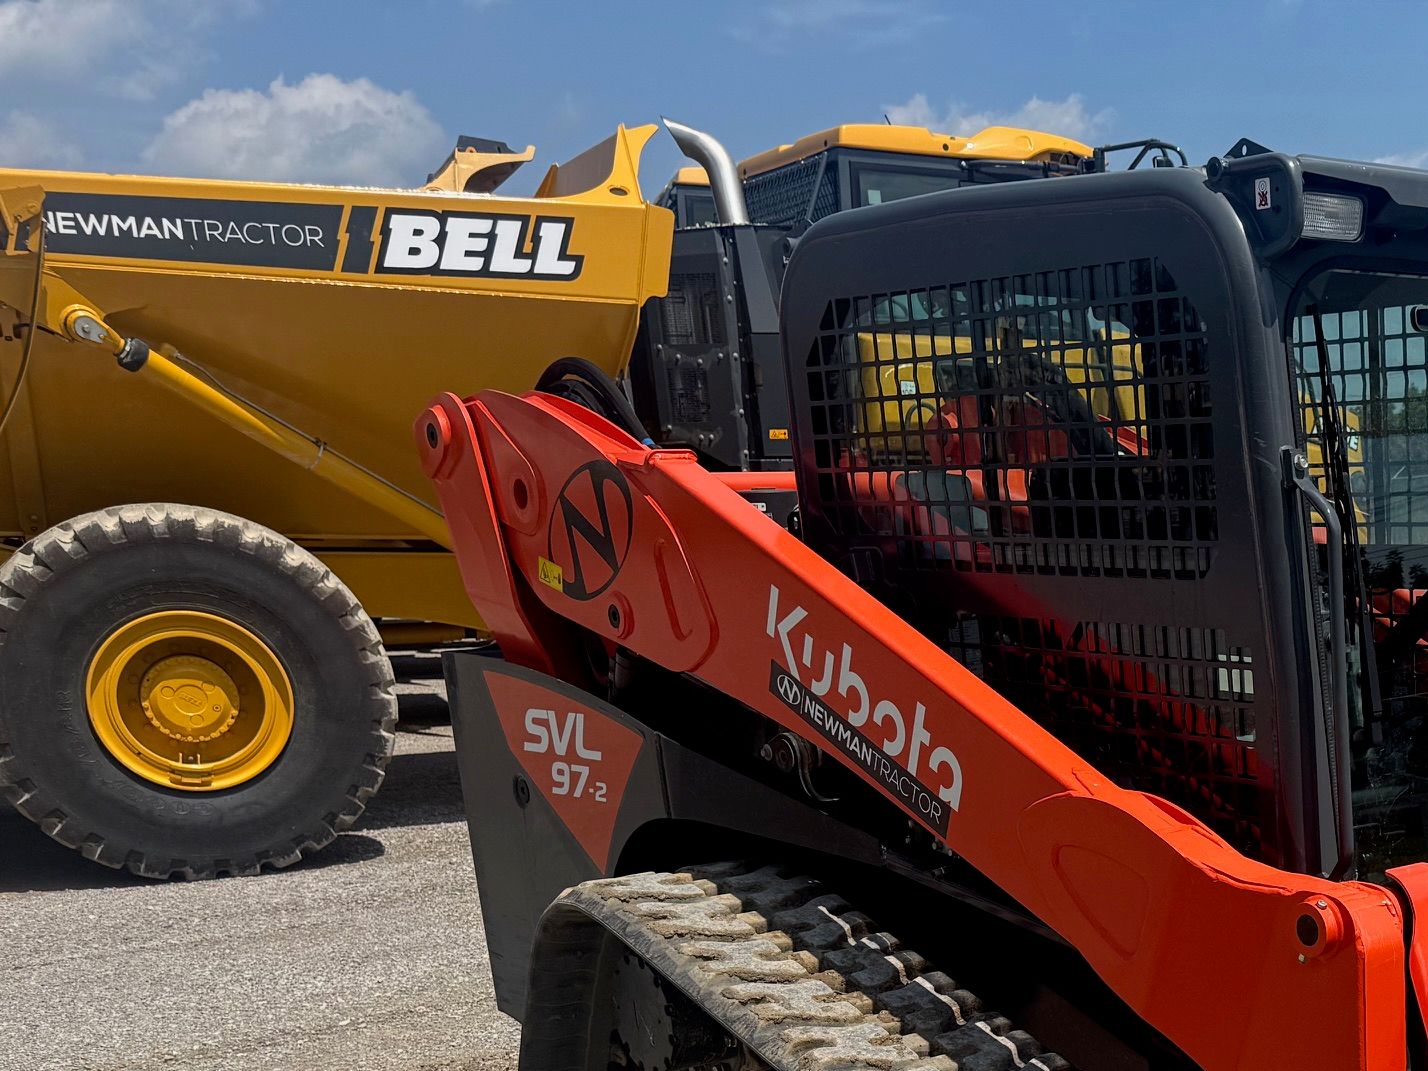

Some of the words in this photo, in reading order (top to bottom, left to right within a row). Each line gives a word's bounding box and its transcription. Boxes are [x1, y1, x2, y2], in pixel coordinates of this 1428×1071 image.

[384, 213, 577, 275] BELL
[767, 584, 962, 812] Kubota
[524, 708, 601, 760] SVL
[551, 762, 607, 803] 97-2
